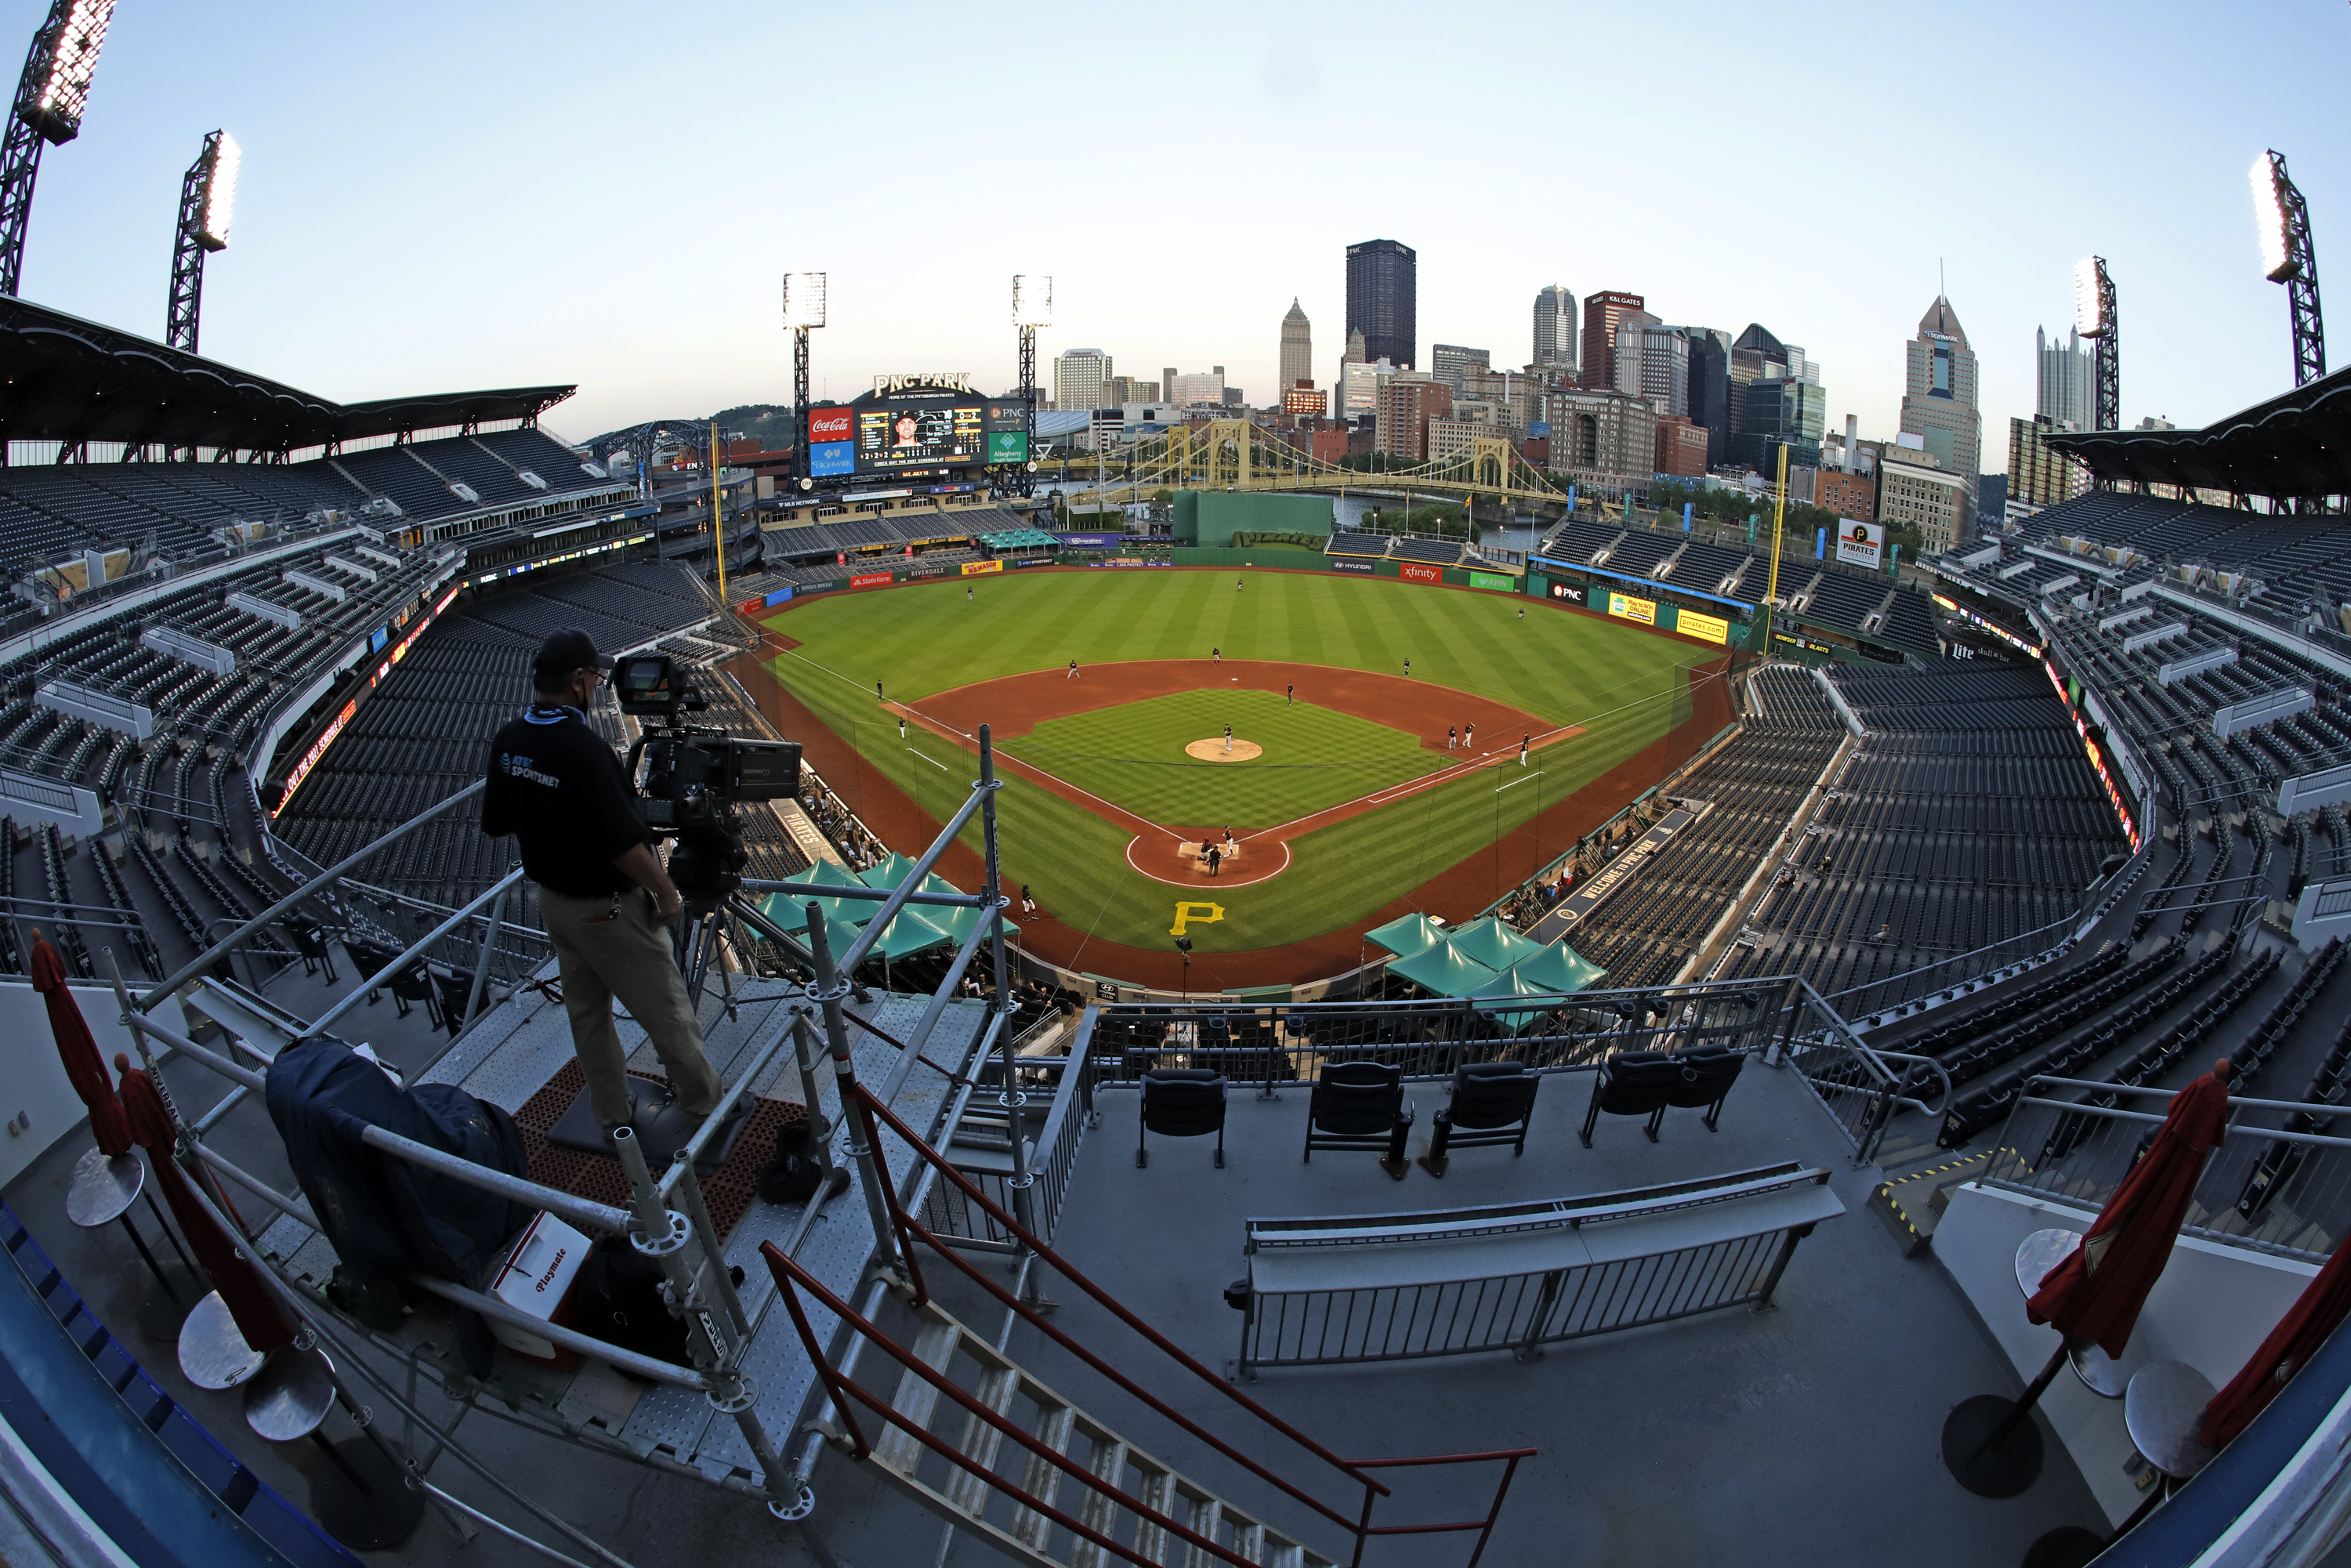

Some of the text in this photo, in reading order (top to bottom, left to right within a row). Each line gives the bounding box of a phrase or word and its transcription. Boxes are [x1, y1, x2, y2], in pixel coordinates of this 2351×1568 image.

[1396, 244, 1407, 255] UPMC
[1621, 297, 1641, 306] GATES
[1928, 332, 1958, 342] HIGHMARK
[874, 372, 972, 399] PNC PARK
[1002, 408, 1024, 418] PNC
[813, 418, 850, 433] Coca-Cola
[816, 459, 852, 469] HIGHMARK
[1857, 529, 1864, 540] P
[1842, 550, 1874, 561] CHARITIES
[1843, 543, 1875, 556] PIRATES
[480, 574, 498, 583] PLESAC
[911, 567, 944, 577] RIVENDALE
[1405, 567, 1436, 581] xfinity
[1488, 578, 1507, 587] AHN
[1563, 588, 1581, 600] PNC
[1629, 606, 1650, 615] ONLINE!
[1682, 618, 1722, 635] pirates.com
[1776, 634, 1797, 644] BOWSER
[1809, 643, 1829, 654] BLASTS
[1952, 643, 2010, 663] Lite skull bar
[287, 715, 344, 791] OUT THE 2021 SCHEDULE AT
[512, 755, 534, 768] AT&T
[511, 766, 560, 788] SPORTSNET
[784, 813, 820, 844] PIRATES
[1581, 839, 1657, 900] WELCOME TO PNC PARK
[1168, 901, 1226, 936] P
[535, 1248, 567, 1293] Playmate
